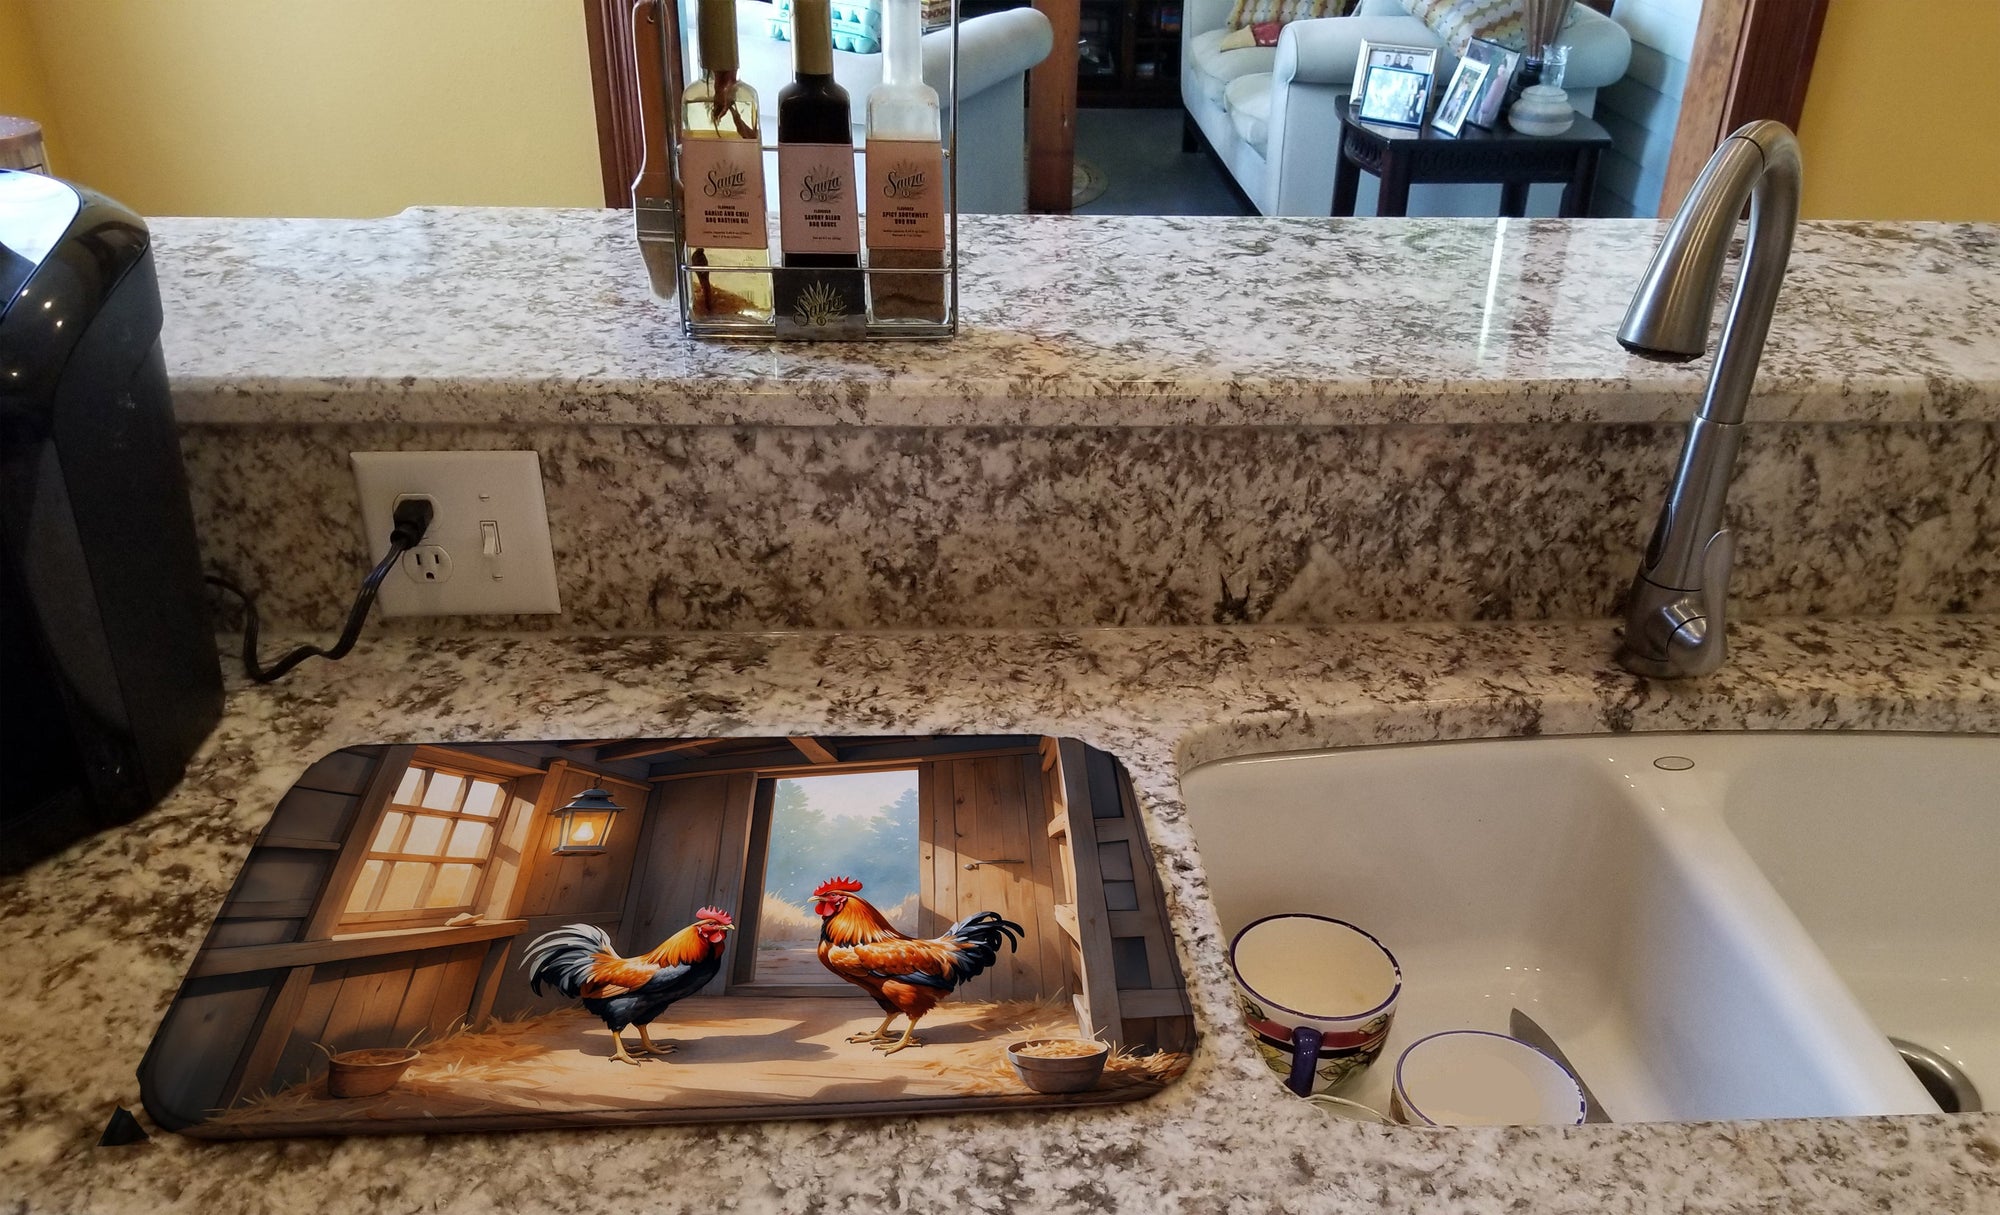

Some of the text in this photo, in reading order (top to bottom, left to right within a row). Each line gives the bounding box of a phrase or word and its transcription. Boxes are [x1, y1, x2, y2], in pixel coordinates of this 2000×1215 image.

[703, 169, 746, 197] Sauza
[800, 175, 842, 202] Sauza
[883, 171, 925, 198] Sauza
[898, 211, 929, 219] SOUTHWEST
[792, 294, 844, 327] Sauza
